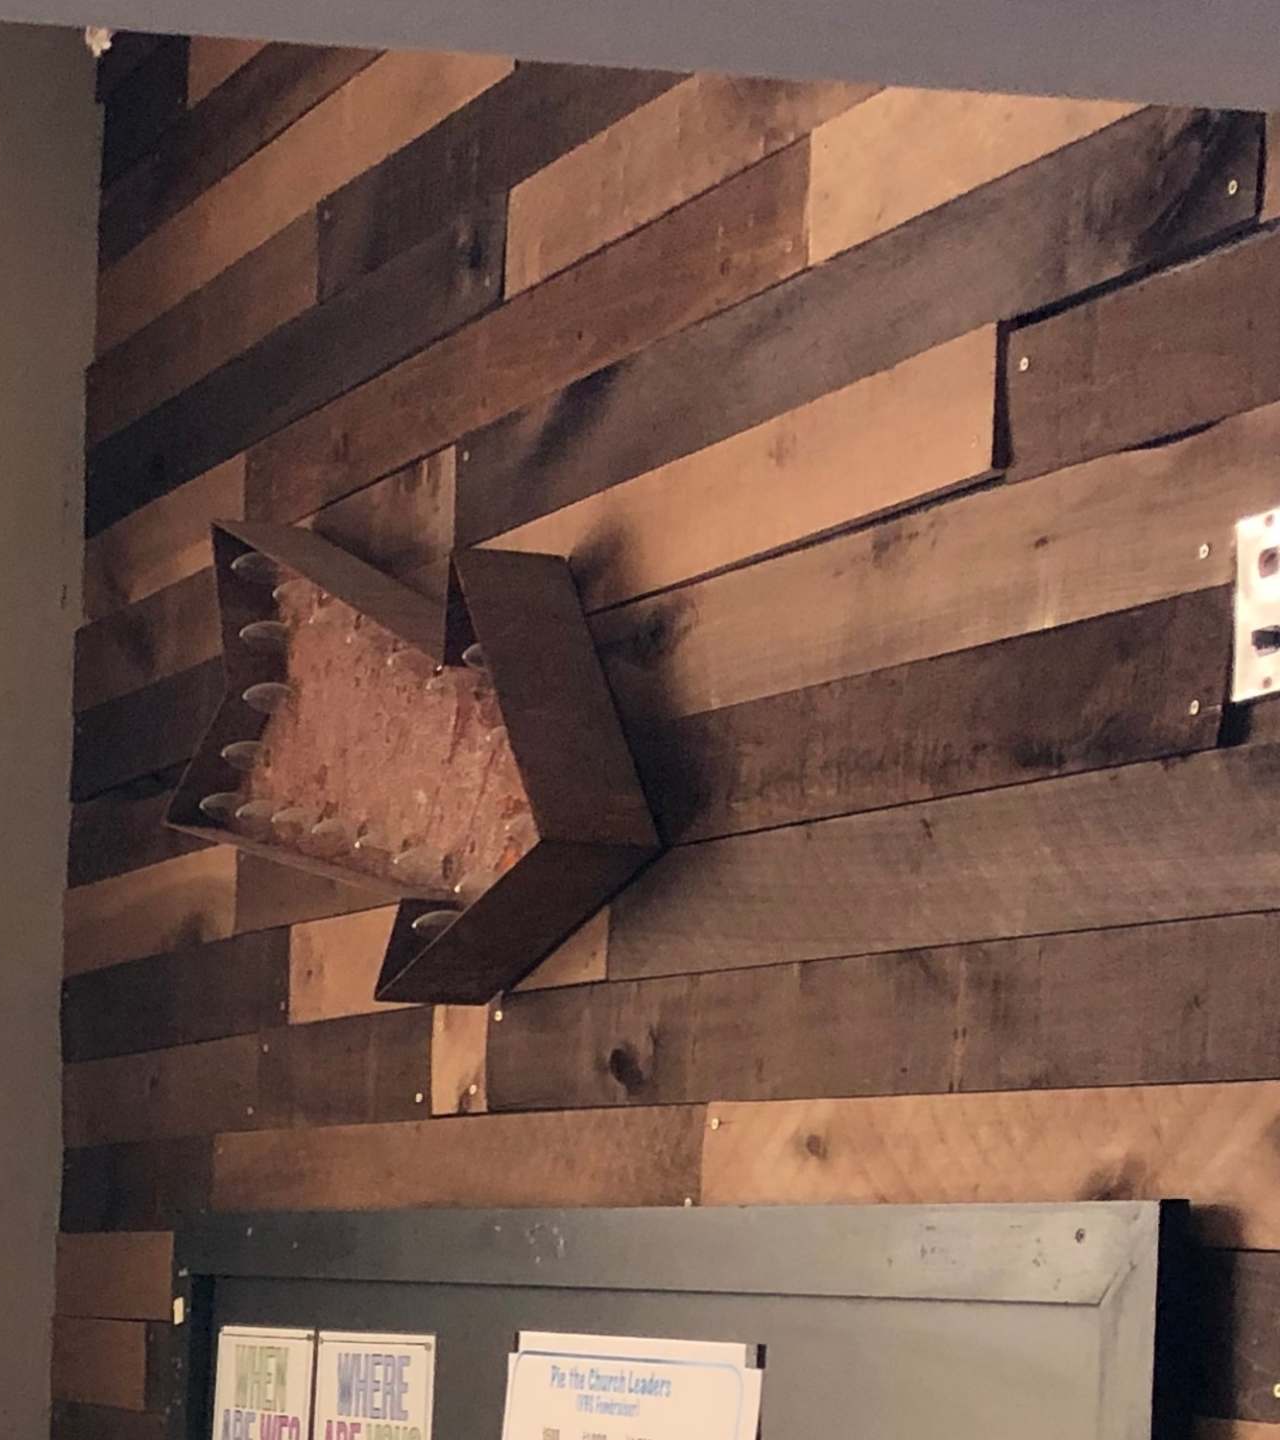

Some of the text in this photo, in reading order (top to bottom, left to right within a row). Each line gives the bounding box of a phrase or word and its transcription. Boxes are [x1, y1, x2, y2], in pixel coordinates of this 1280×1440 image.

[235, 1344, 289, 1412] WHEN
[337, 1353, 411, 1421] WHERE
[569, 1366, 586, 1390] the
[589, 1368, 626, 1394] Church
[628, 1371, 672, 1397] Leaders
